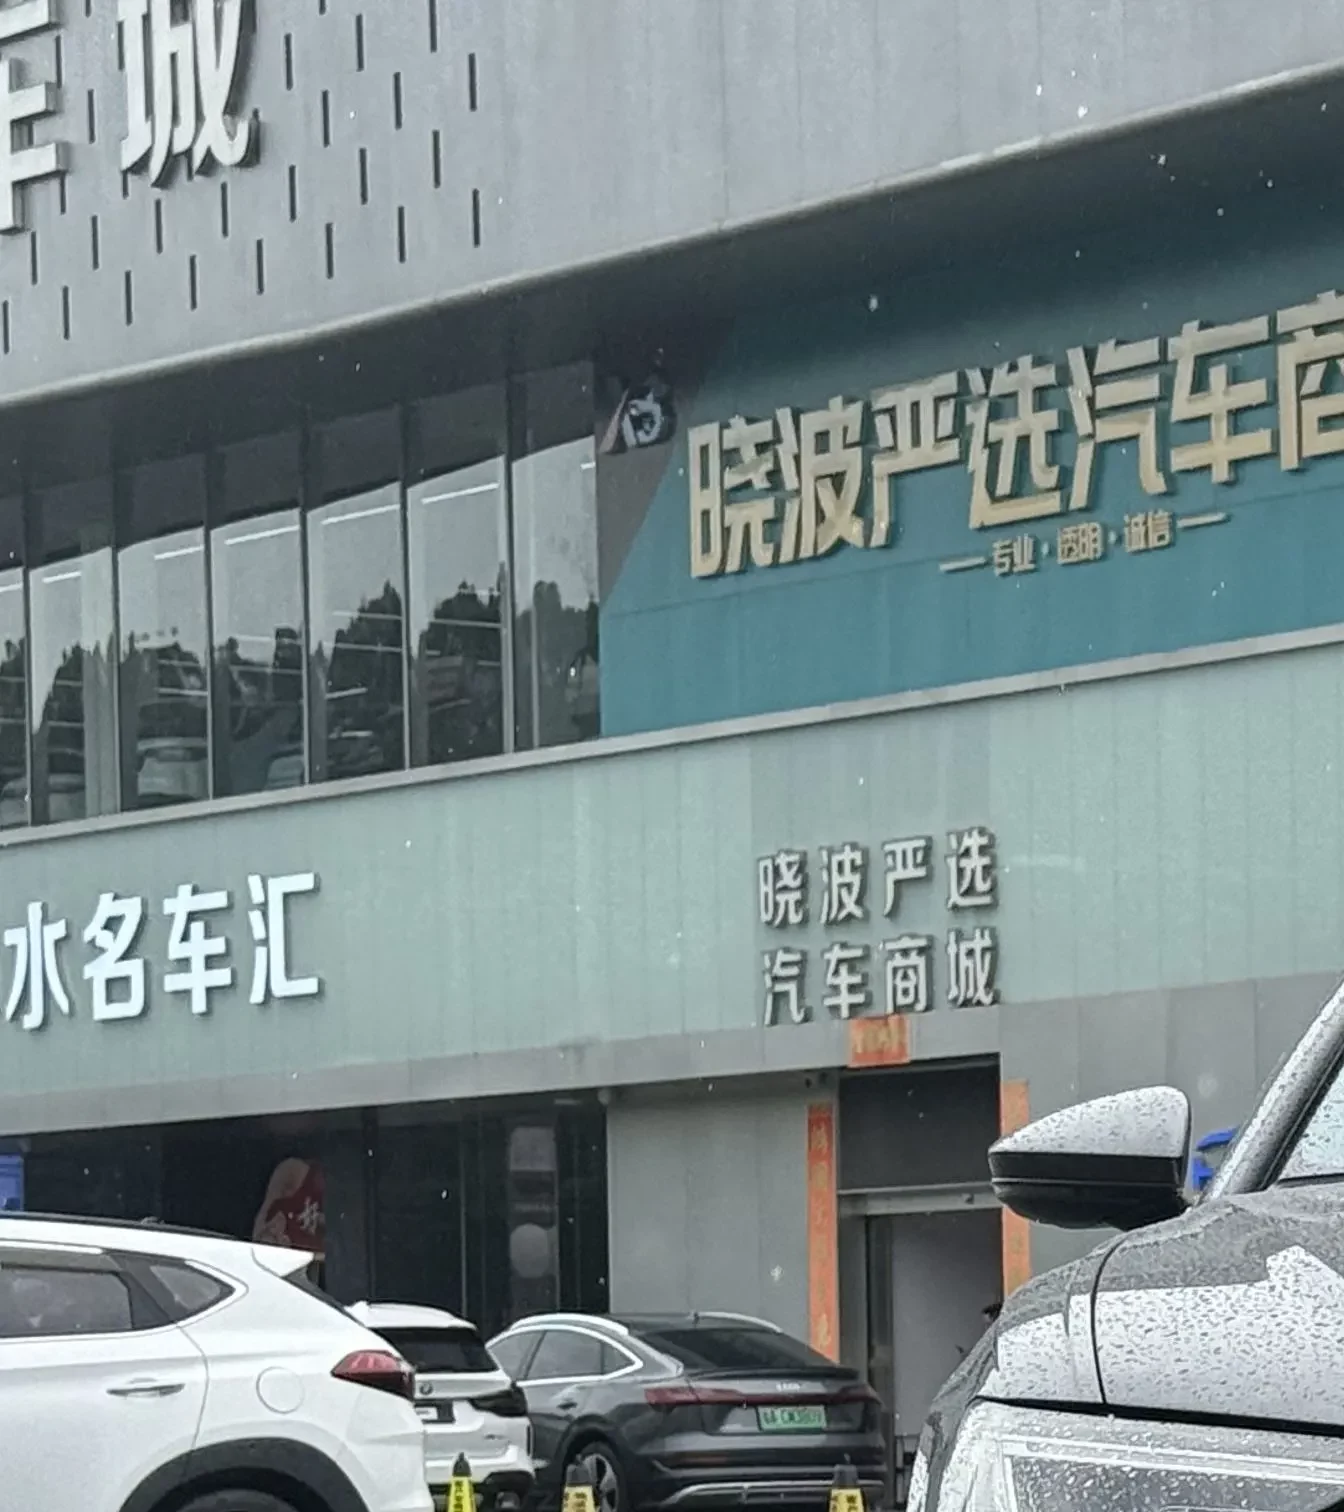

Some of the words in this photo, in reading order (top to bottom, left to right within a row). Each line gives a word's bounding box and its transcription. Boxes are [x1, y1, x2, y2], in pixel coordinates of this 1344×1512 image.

[758, 826, 996, 928] 晓波严选
[4, 872, 319, 1031] 水名车汇
[763, 927, 998, 1026] 汽车商城
